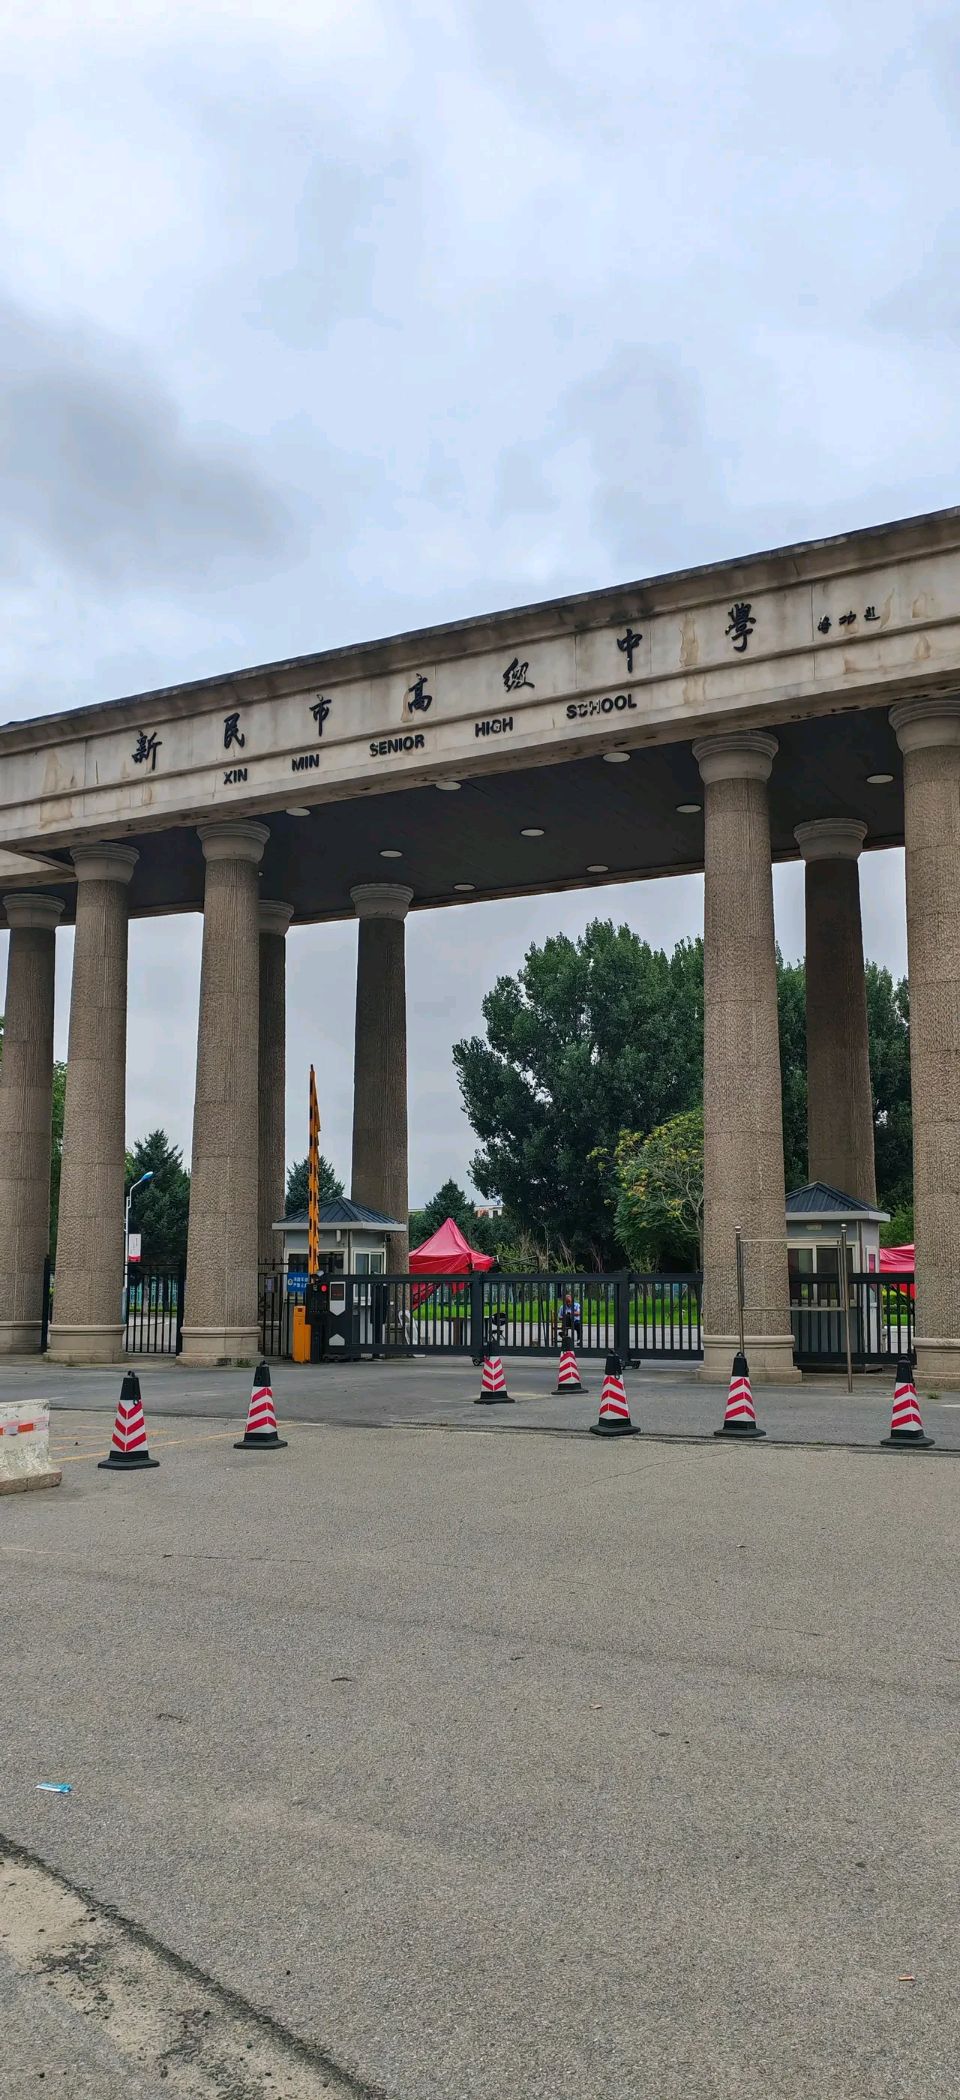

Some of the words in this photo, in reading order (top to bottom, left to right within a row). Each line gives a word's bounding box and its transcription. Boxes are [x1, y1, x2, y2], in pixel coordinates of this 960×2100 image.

[223, 767, 248, 785] XIN
[291, 753, 320, 772] MIN
[369, 734, 425, 757] SENIOR
[474, 716, 514, 737] HIGH
[566, 693, 638, 719] SCHOOL
